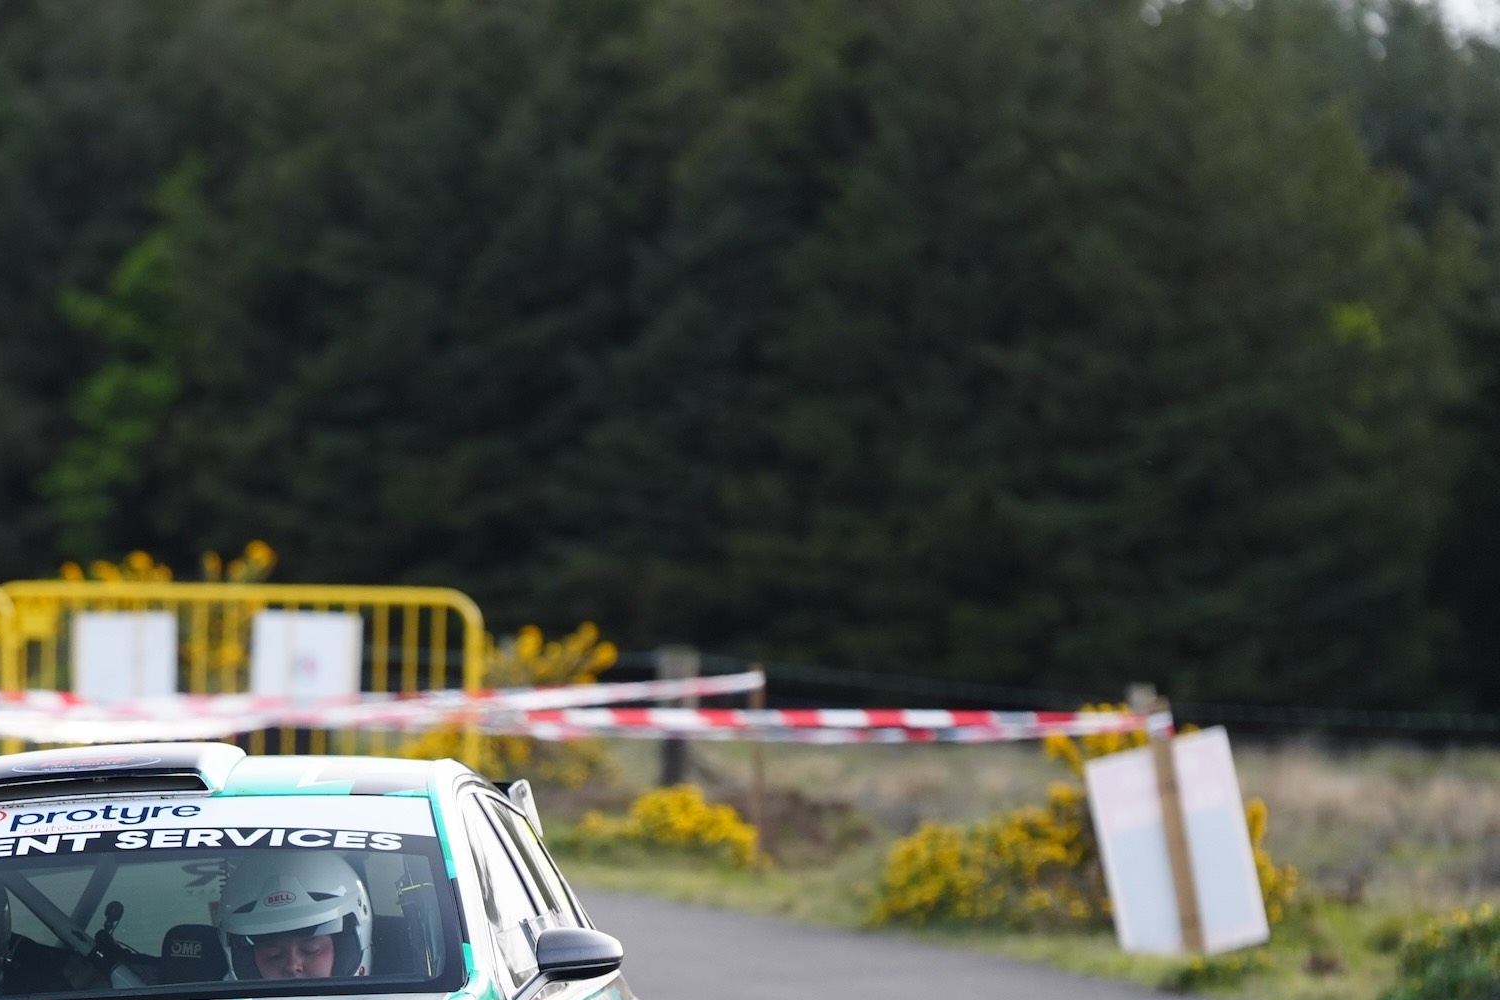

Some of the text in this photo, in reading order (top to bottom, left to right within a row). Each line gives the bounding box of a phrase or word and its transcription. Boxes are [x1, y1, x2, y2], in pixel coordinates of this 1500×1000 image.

[10, 805, 201, 832] protyre
[24, 822, 113, 834] autocare
[114, 828, 403, 851] SERVICES
[267, 893, 293, 905] BELL
[171, 941, 203, 956] OMP
